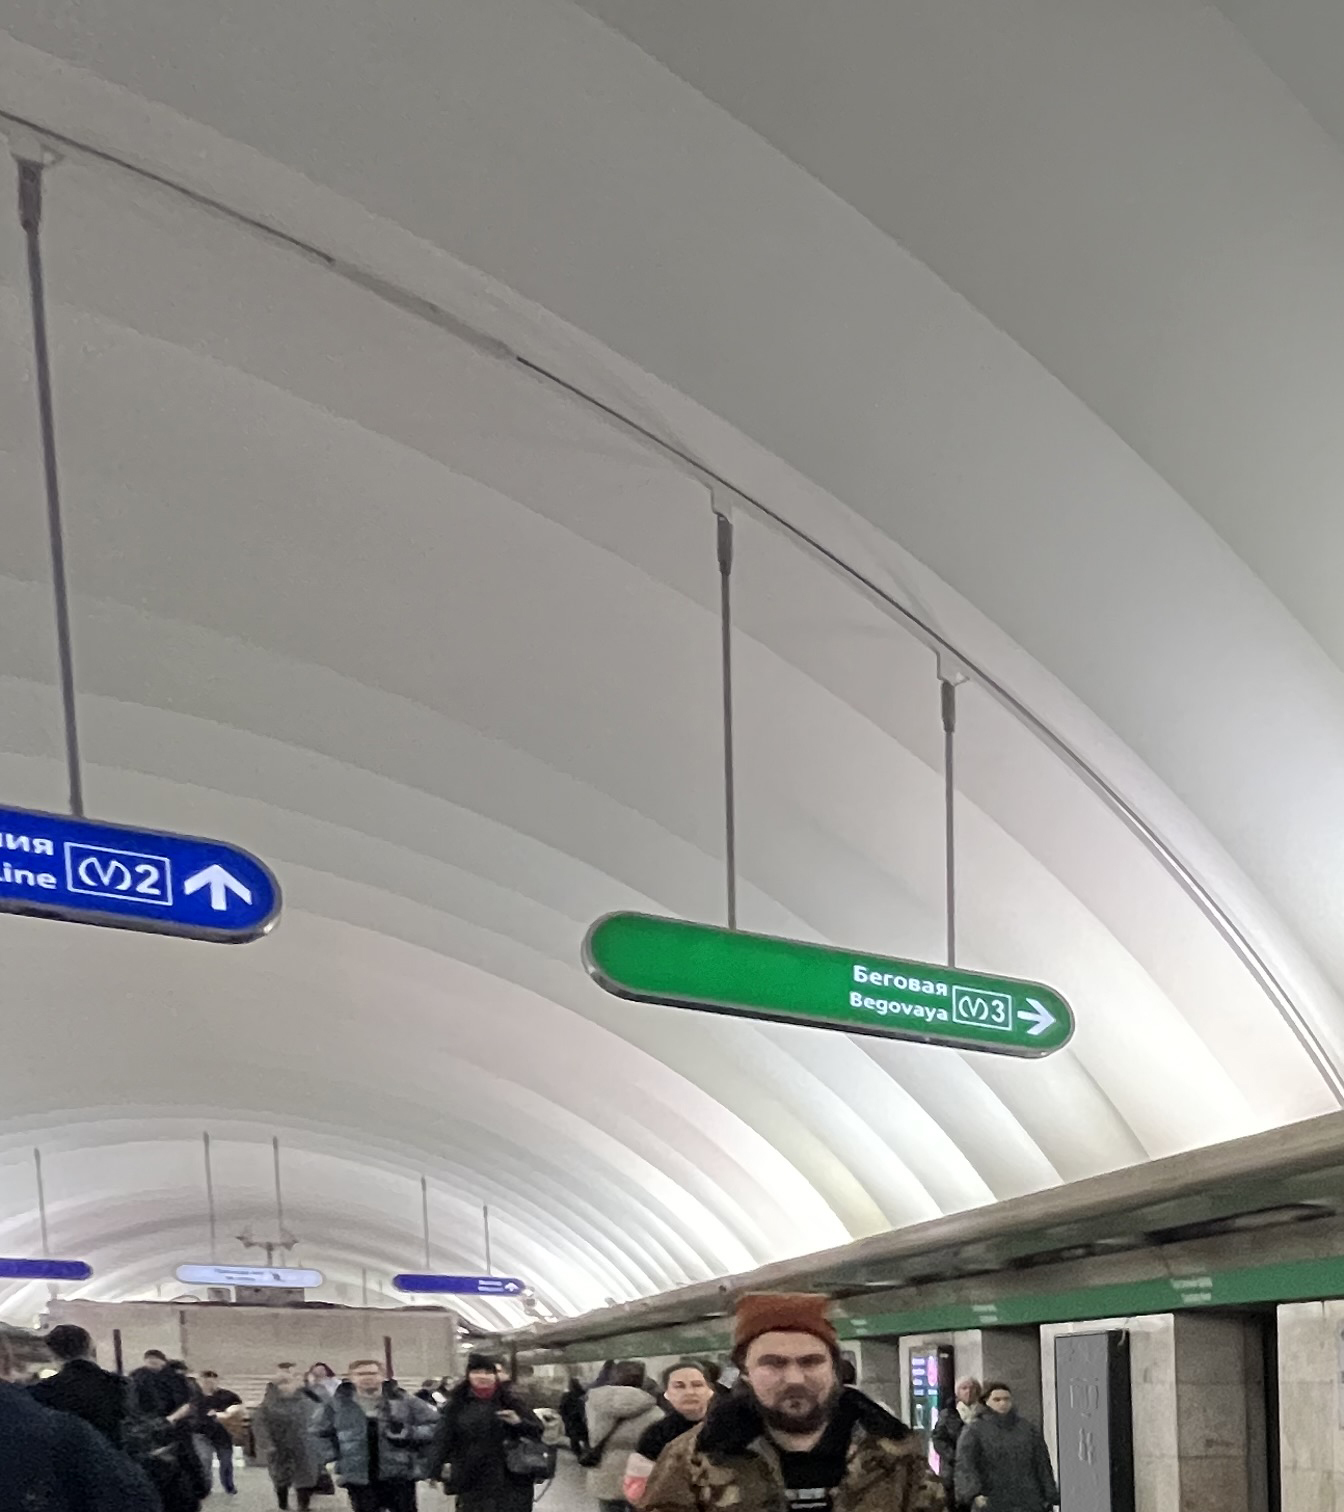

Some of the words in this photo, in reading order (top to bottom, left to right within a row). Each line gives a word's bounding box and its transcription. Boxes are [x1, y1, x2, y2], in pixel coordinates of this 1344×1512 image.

[0, 832, 54, 856] ия
[0, 861, 57, 890] ine
[852, 964, 948, 997] Беговая
[849, 991, 949, 1022] Begovaya
